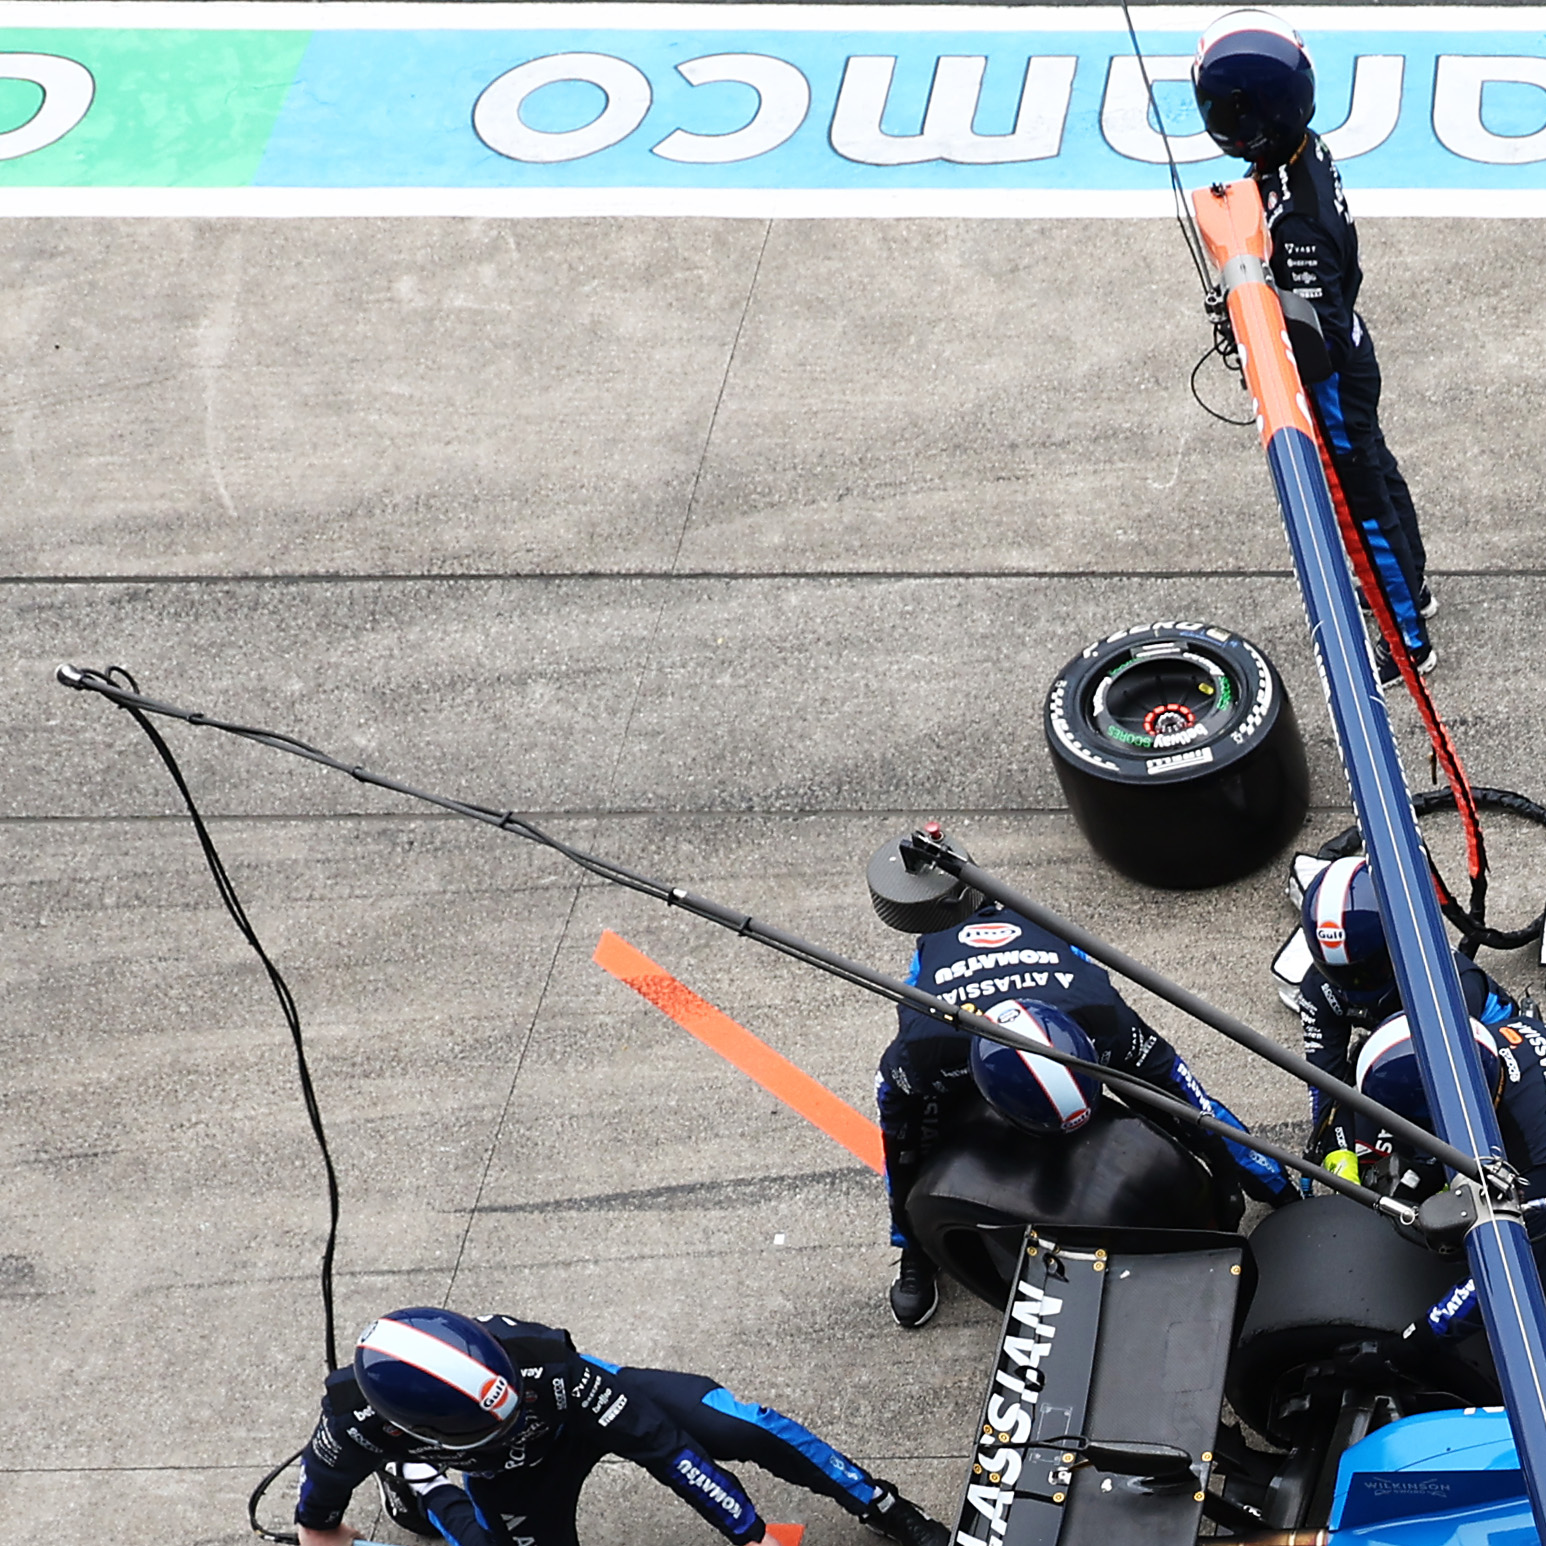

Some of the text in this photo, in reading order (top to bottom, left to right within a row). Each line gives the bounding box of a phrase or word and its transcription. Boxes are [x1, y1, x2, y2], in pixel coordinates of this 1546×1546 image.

[1153, 722, 1209, 750] betway
[1316, 928, 1345, 941] Gulf
[934, 949, 1060, 985] KOMATSU
[941, 971, 1050, 1006] ATLASSIA
[481, 1375, 508, 1411] Gulf
[675, 1456, 745, 1519] KOMATSU
